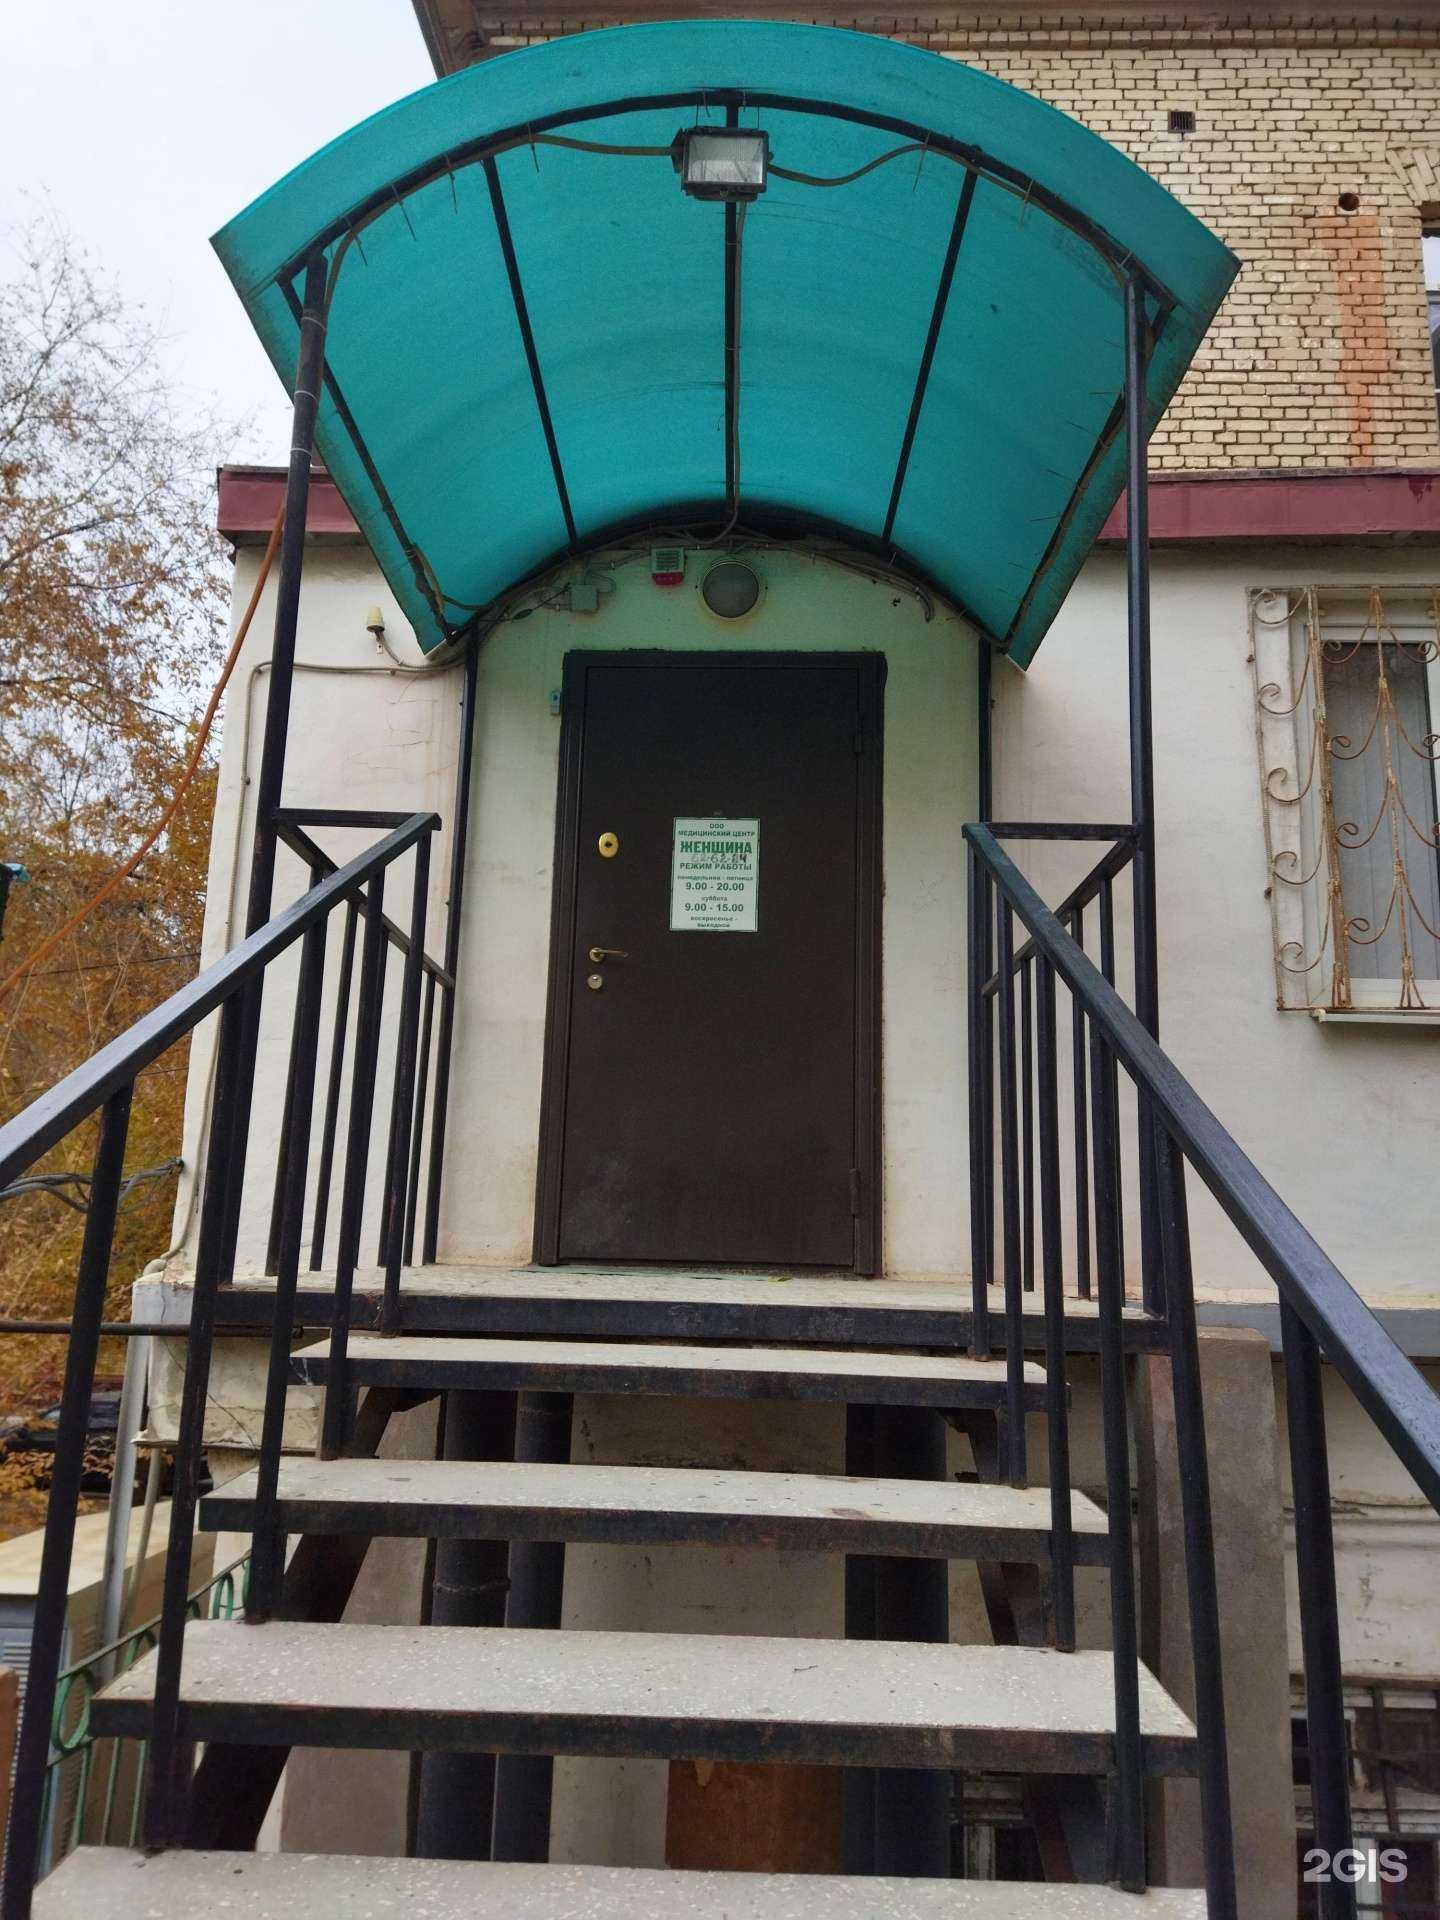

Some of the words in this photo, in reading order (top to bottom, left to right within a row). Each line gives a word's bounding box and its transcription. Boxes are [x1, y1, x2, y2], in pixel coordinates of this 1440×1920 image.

[680, 841, 752, 854] ЖЕНЩИНА
[680, 862, 712, 870] РЕЖИМ
[715, 863, 752, 871] РАБОТЫ
[686, 882, 707, 890] 9.00
[716, 882, 745, 891] 20.00
[685, 903, 707, 911] 9.00
[716, 903, 744, 912] 15.00
